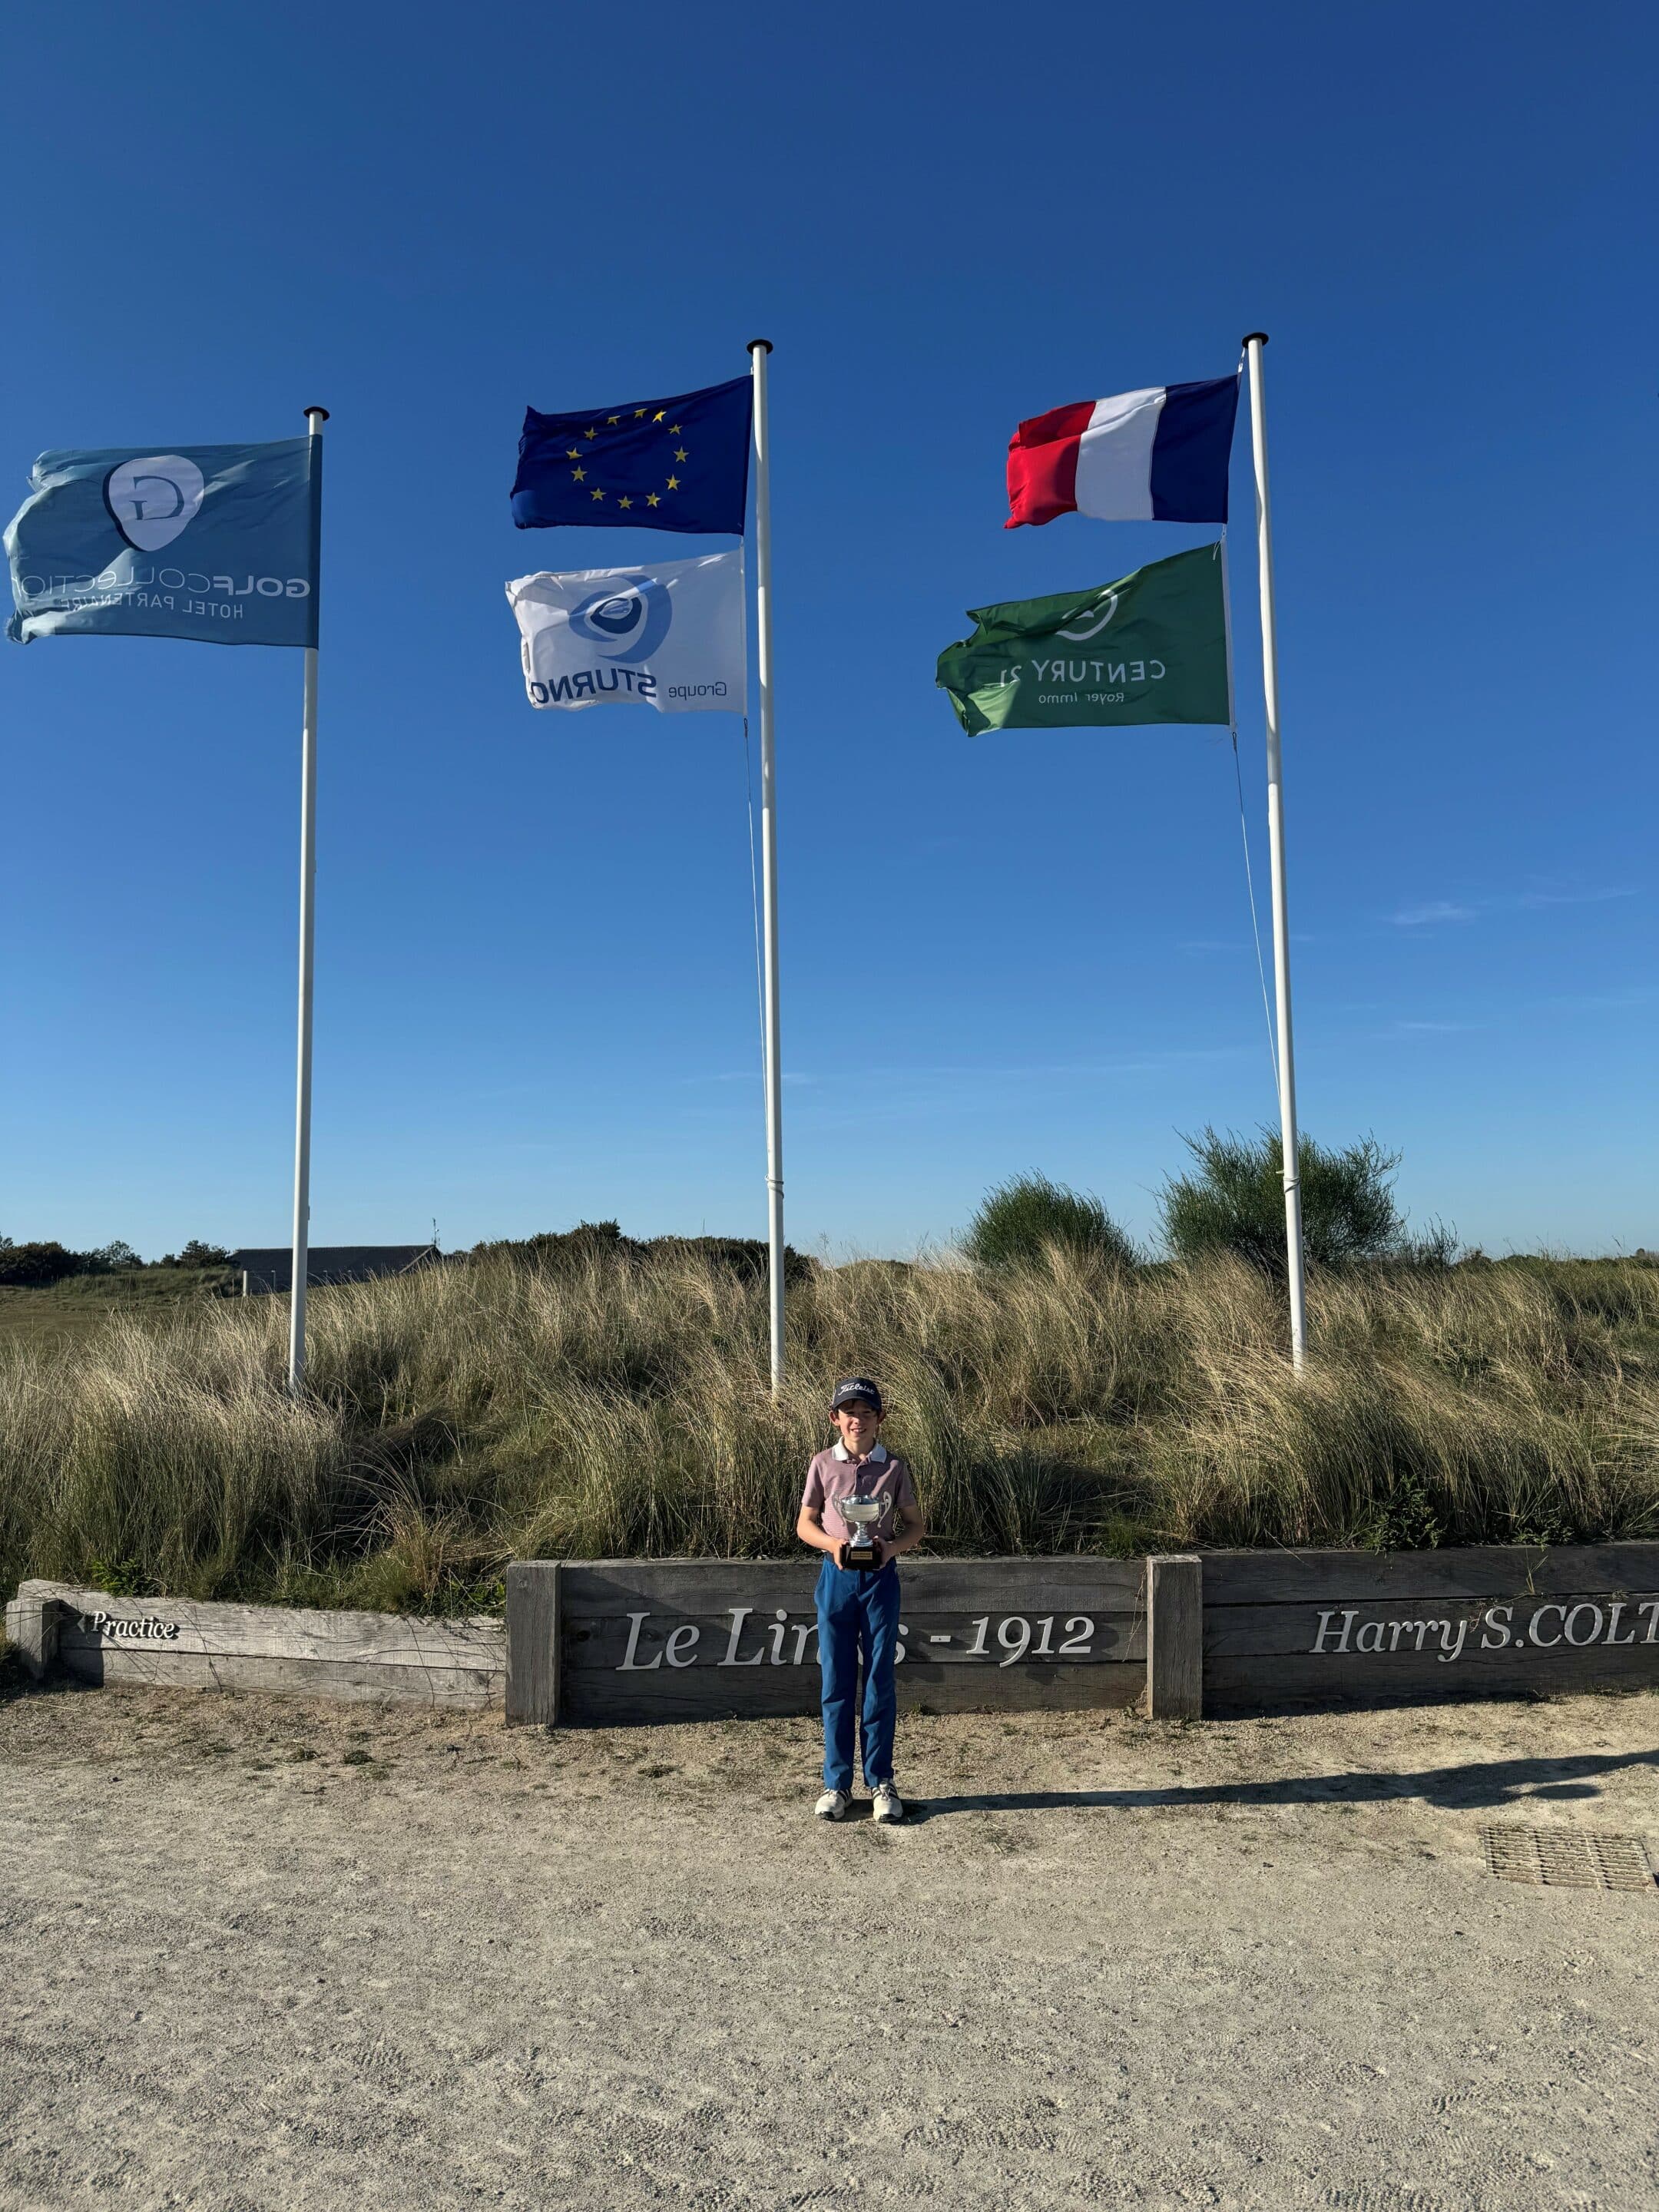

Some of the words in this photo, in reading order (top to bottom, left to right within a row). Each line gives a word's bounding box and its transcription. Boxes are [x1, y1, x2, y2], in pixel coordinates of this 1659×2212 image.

[91, 1611, 174, 1638] Practice
[615, 1611, 700, 1671] Le
[966, 1617, 1095, 1667] 1912
[1309, 1611, 1468, 1662] Harry
